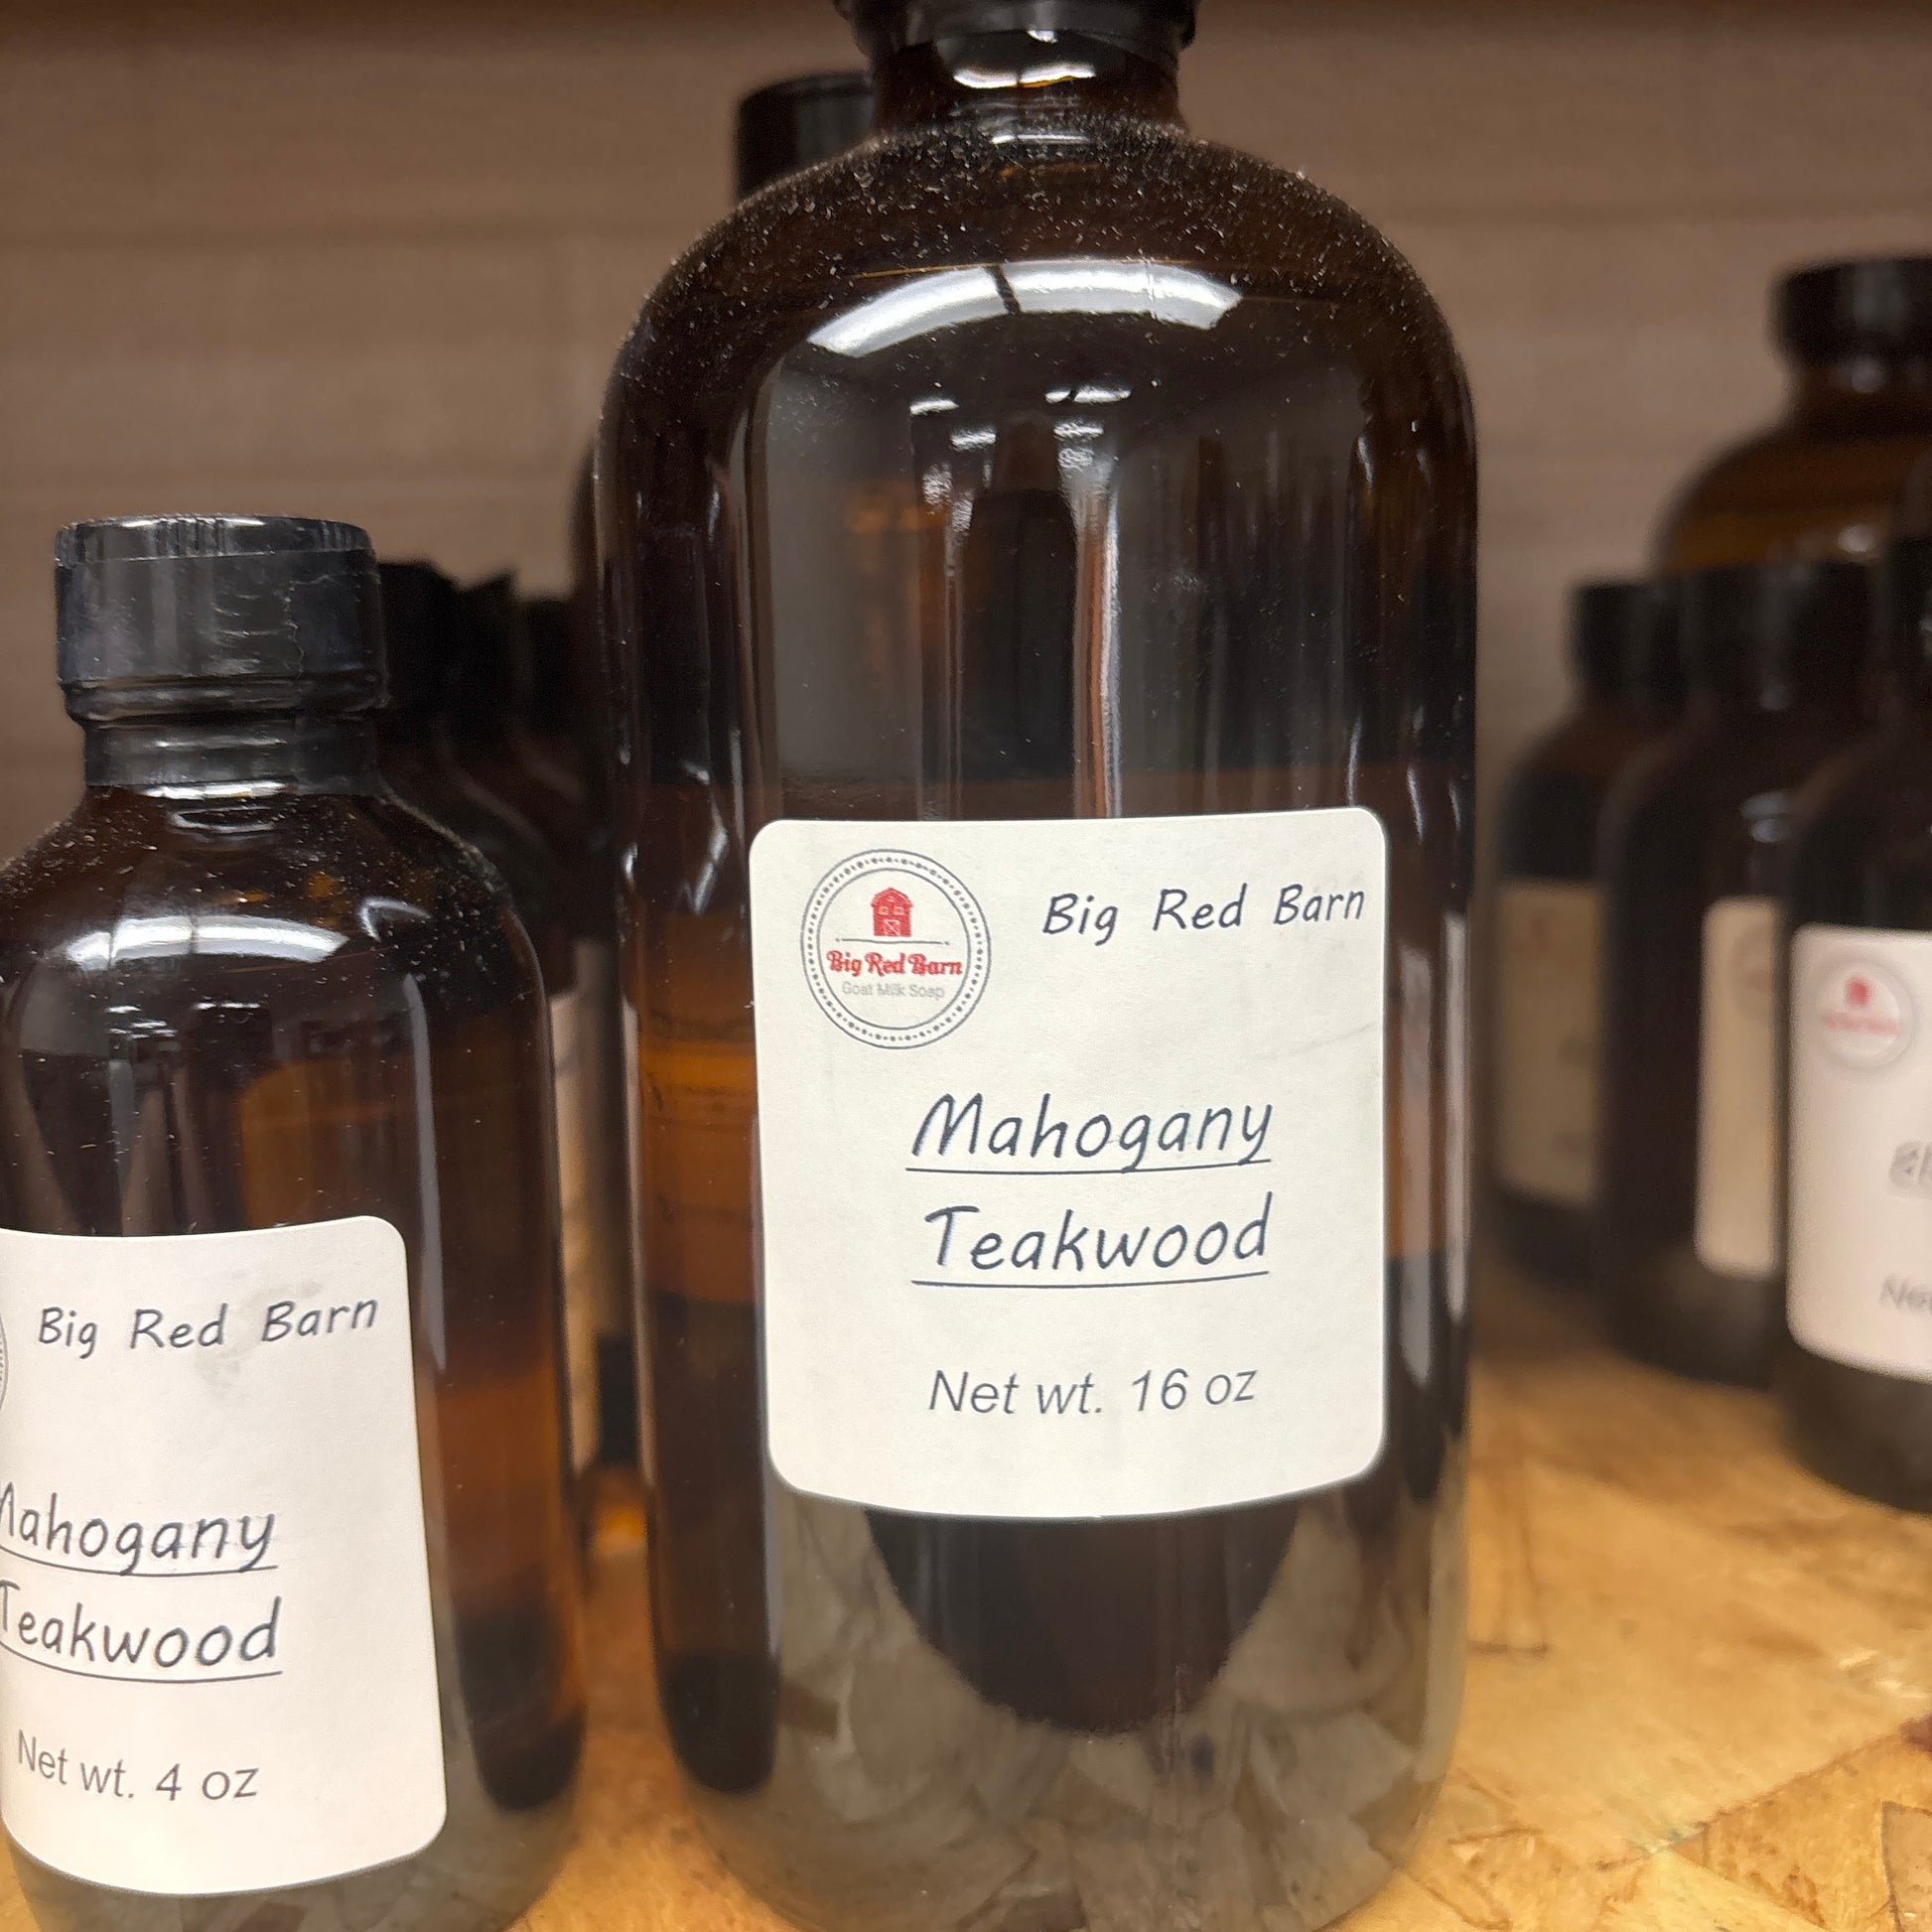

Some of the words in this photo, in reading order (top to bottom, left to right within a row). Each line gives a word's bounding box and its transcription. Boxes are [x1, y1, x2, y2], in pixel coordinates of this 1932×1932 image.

[1041, 893, 1119, 946] Big
[1152, 883, 1249, 933] Red
[1272, 883, 1367, 927] Barn
[826, 949, 863, 978] Big
[864, 951, 907, 978] Red
[907, 952, 964, 977] Barn
[841, 981, 874, 997] Goat
[877, 982, 907, 998] Milk
[908, 983, 946, 1001] Soap
[909, 1091, 1274, 1173] Mahogany
[923, 1190, 1274, 1273] Teakwood
[37, 1306, 98, 1360] Big
[129, 1302, 229, 1350] Red
[260, 1298, 379, 1343] Barn
[928, 1368, 1021, 1416] Net
[1035, 1370, 1103, 1416] wt.
[1130, 1367, 1189, 1412] 16
[1203, 1368, 1259, 1406] oz
[17, 1728, 69, 1786] Net
[79, 1758, 135, 1799] wt.
[155, 1762, 183, 1802] 4
[201, 1766, 260, 1801] oz
